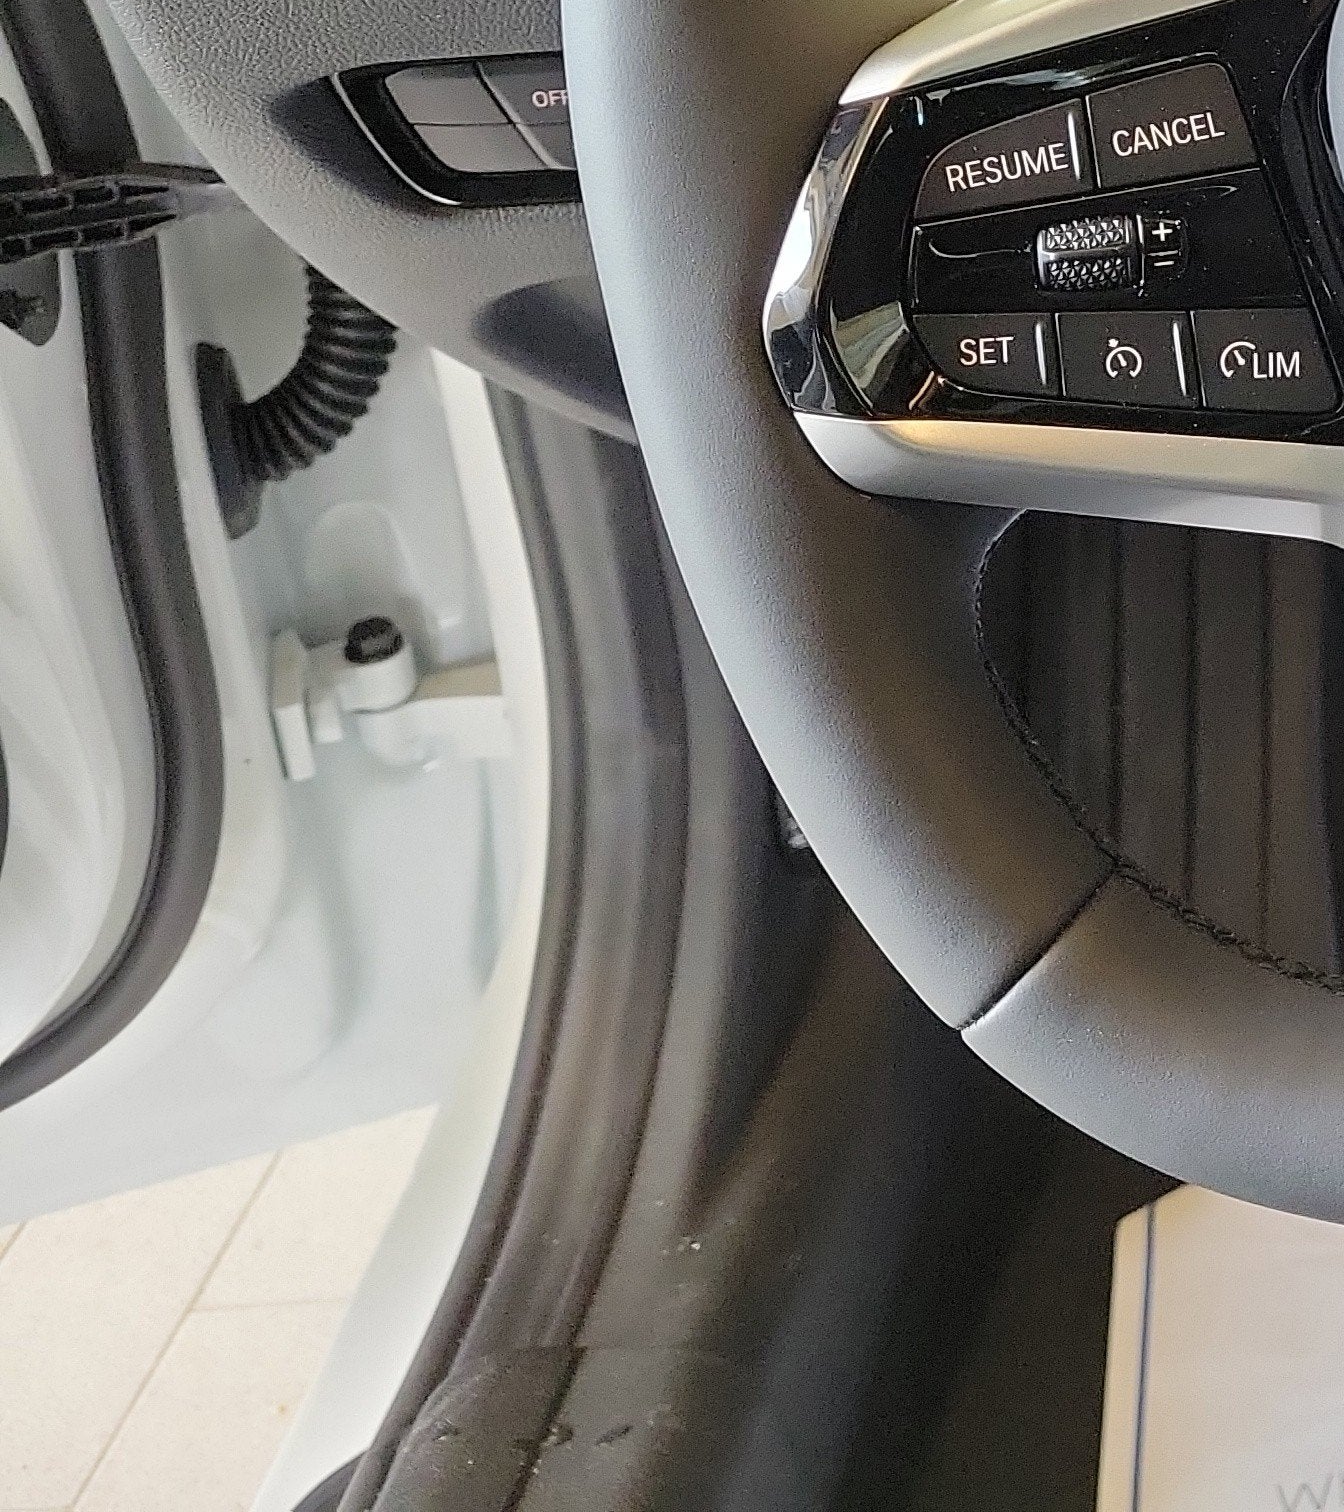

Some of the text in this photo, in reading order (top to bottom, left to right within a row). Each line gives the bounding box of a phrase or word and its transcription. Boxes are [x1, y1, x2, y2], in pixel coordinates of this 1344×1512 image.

[1111, 111, 1226, 158] CANCEL
[944, 142, 1070, 192] RESUME
[958, 335, 1014, 366] SET
[1252, 350, 1301, 379] LIM
